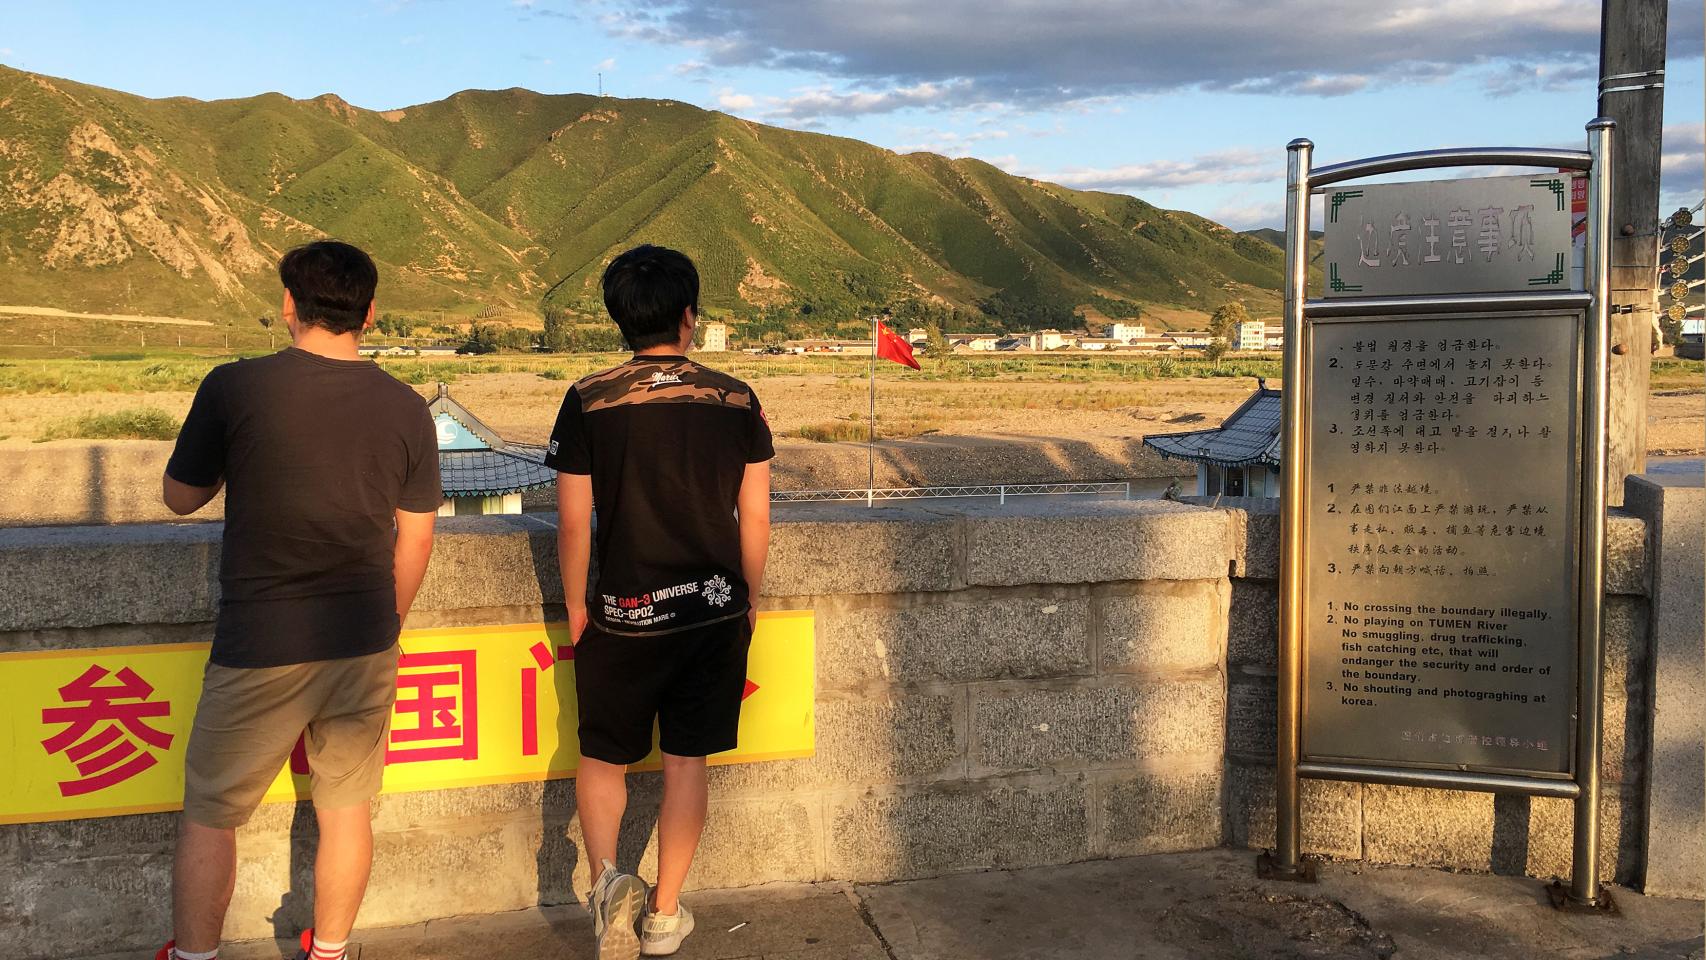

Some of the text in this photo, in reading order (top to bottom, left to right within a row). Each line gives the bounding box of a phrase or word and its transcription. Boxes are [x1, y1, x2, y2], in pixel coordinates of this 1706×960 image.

[1464, 374, 1519, 388] 고기잡이
[1531, 375, 1544, 386] 등
[1434, 392, 1476, 404] 안전을
[602, 582, 699, 608] THE GAN-3 UNIVERSE
[1344, 602, 1359, 611] No
[1364, 604, 1412, 614] crossing
[1418, 605, 1436, 614] the
[1442, 606, 1495, 618] boundary
[1500, 608, 1552, 620] illegally.
[1344, 616, 1359, 624] No
[1364, 617, 1404, 628] playing
[1429, 619, 1471, 629] TUMEN
[1478, 621, 1507, 630] River
[1342, 629, 1357, 638] No
[1431, 633, 1456, 644] drug
[1342, 643, 1499, 658] fish catching etc, that will
[1342, 657, 1551, 675] endanger the security and order of
[1342, 670, 1421, 683] the boundary.
[1344, 683, 1358, 691] No
[1364, 684, 1412, 696] shouting
[1417, 688, 1437, 696] and
[1443, 688, 1528, 703] photograghing
[1534, 694, 1546, 703] at
[1342, 696, 1377, 706] korea.
